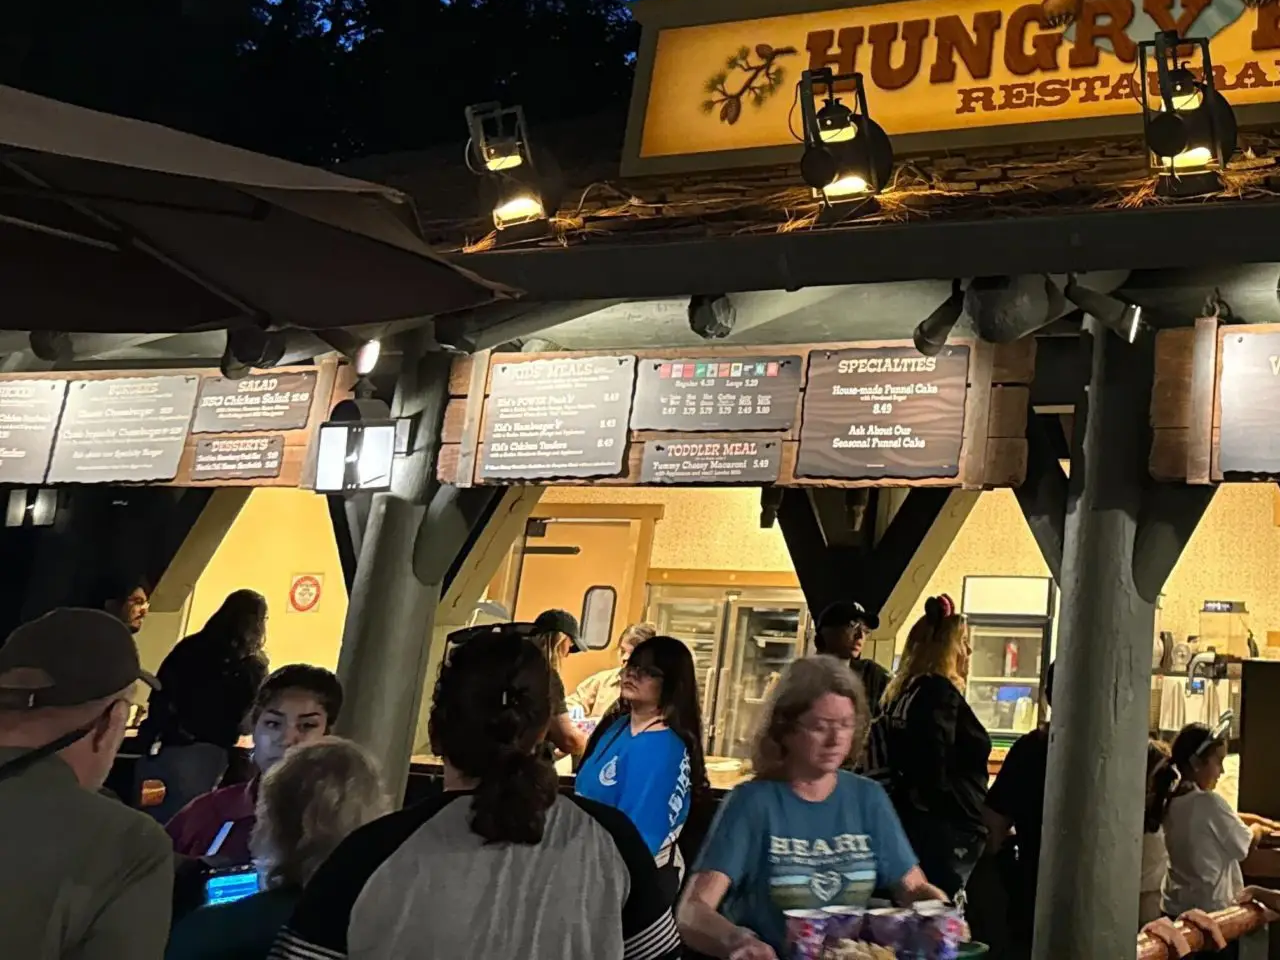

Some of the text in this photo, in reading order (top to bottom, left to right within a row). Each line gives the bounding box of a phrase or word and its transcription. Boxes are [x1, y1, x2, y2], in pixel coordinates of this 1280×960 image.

[838, 357, 937, 373] SPECIALTIES
[238, 378, 278, 393] SALAD
[832, 383, 938, 395] House-made Funnel Cake
[872, 403, 893, 415] 8.49
[848, 425, 912, 436] Ask About Our
[832, 437, 926, 448] Seasonal Funnel Cake
[667, 443, 757, 457] TODDLER MEAL
[653, 461, 680, 471] Yummy
[710, 460, 747, 469] Macaroni
